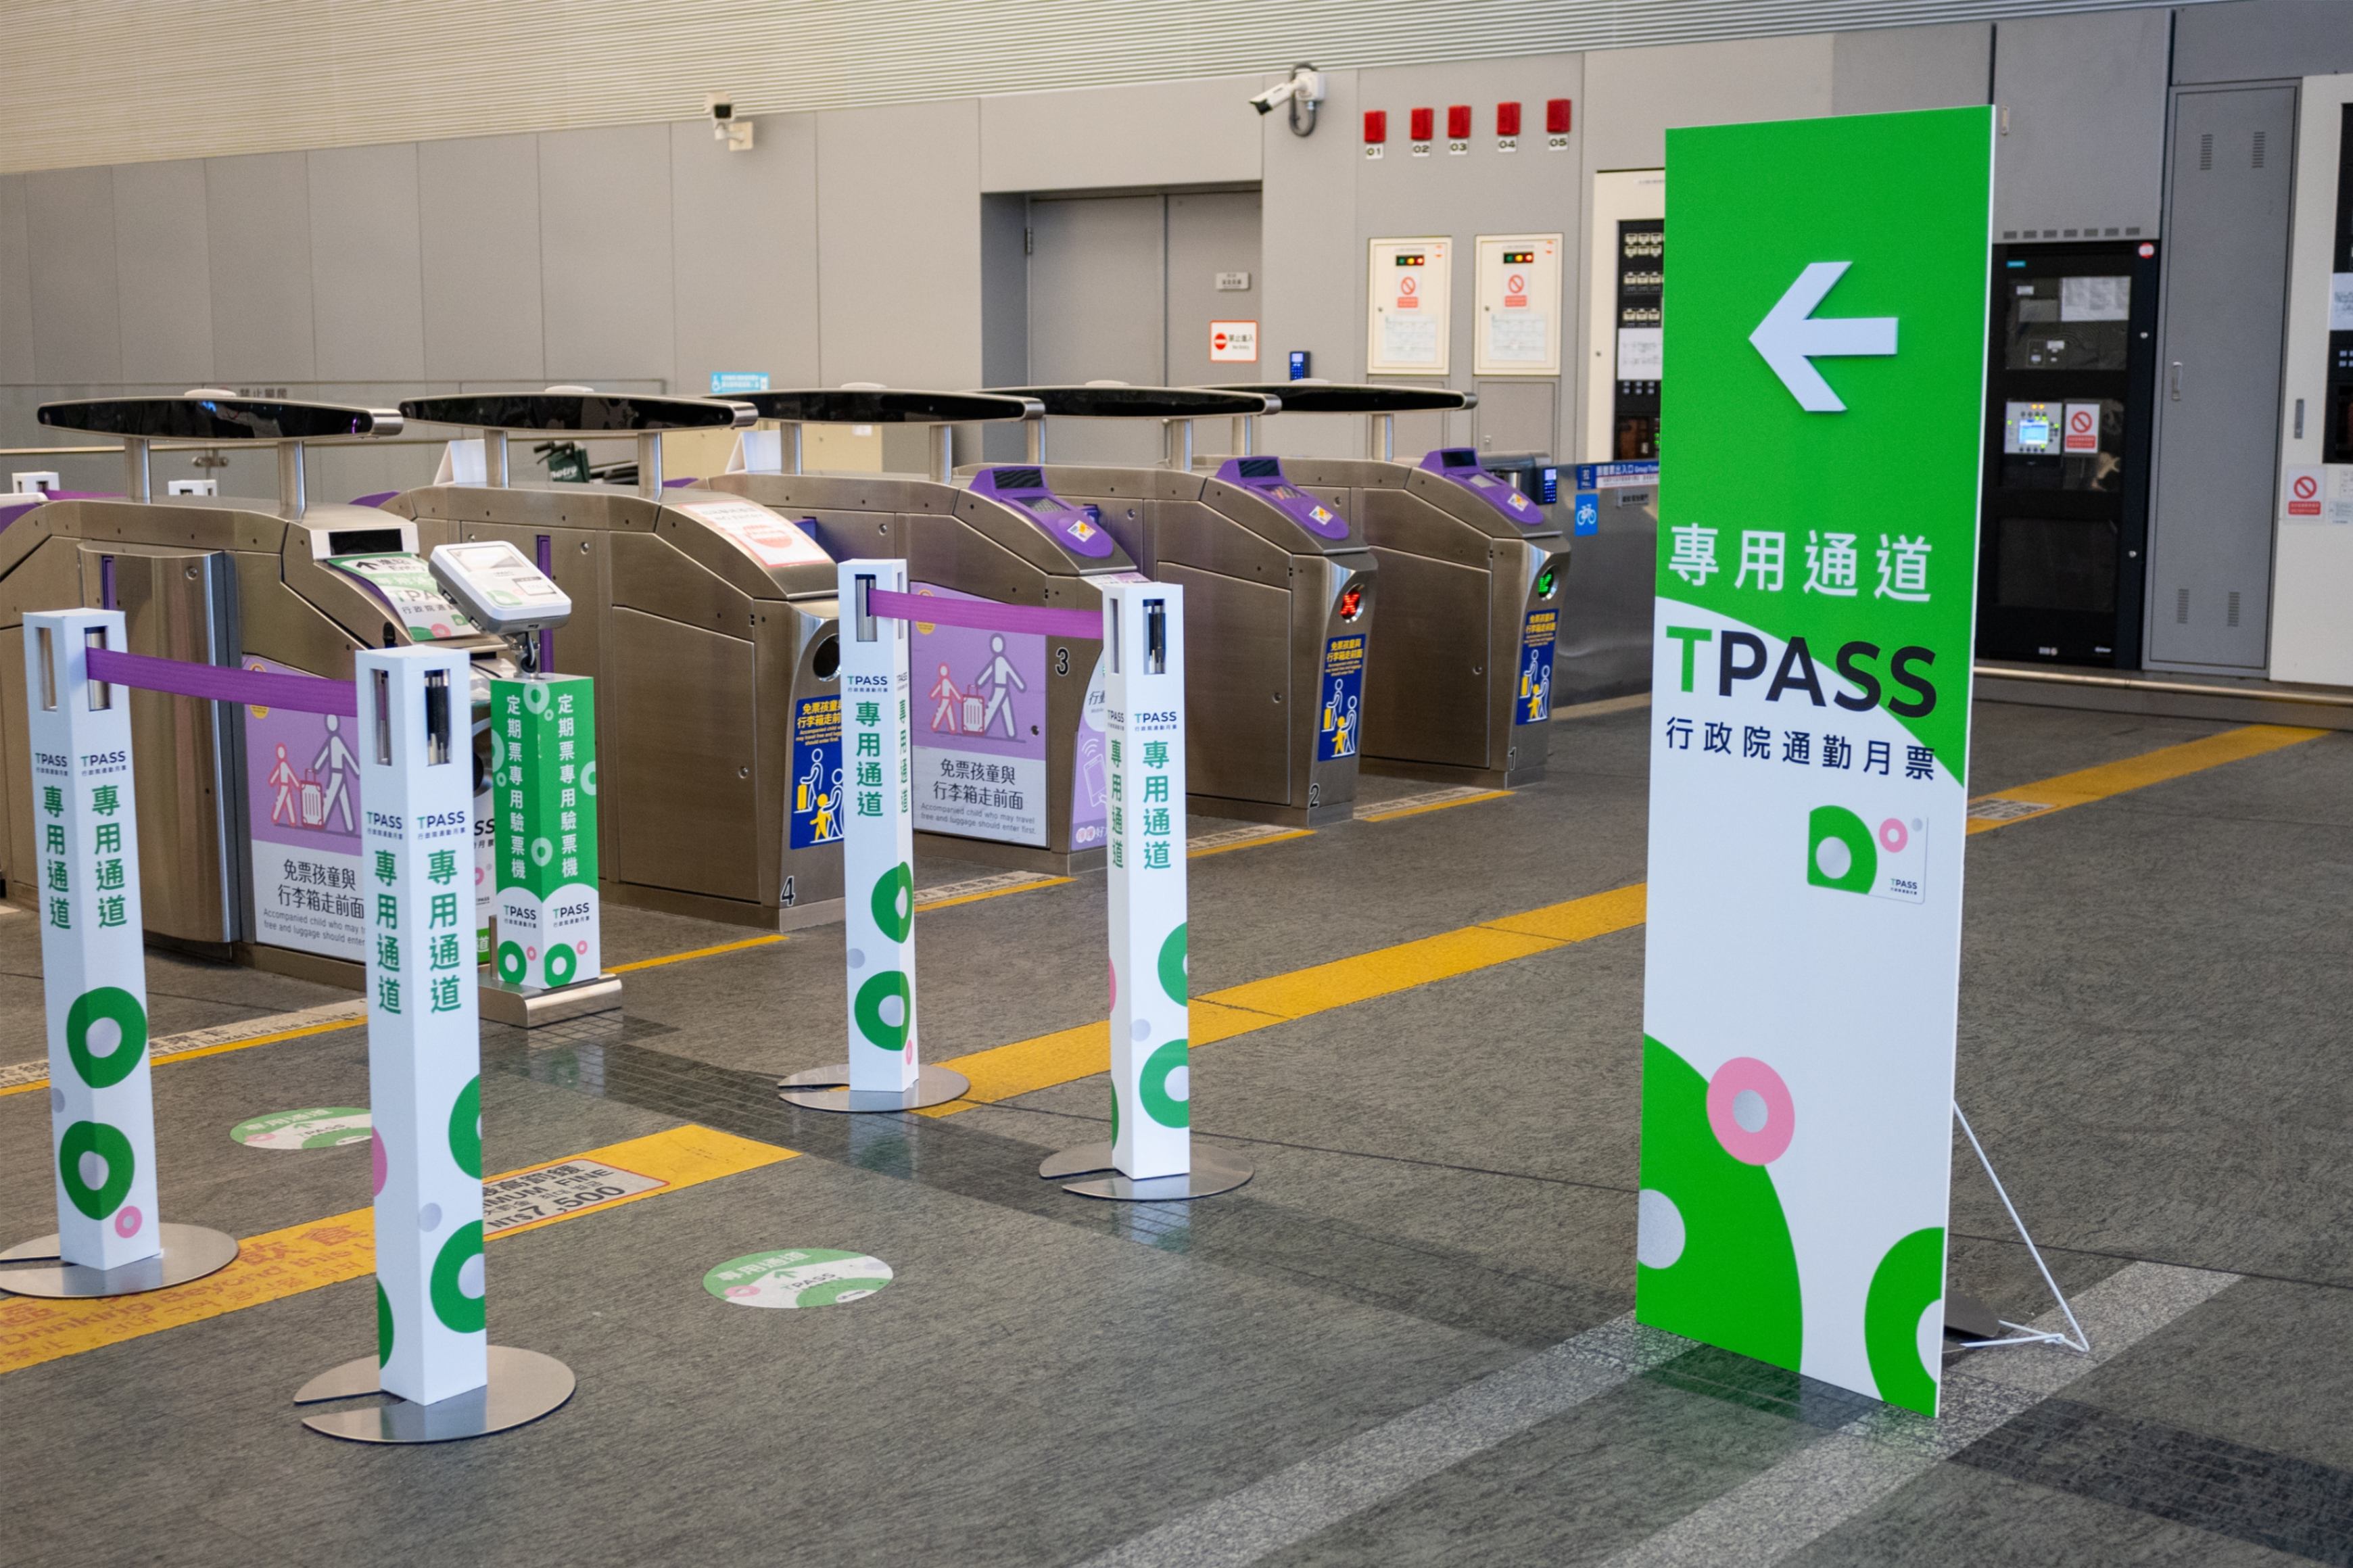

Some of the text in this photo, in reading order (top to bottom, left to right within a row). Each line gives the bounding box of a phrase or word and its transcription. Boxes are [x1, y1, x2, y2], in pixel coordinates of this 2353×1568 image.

[1366, 147, 1381, 156] 01
[1413, 145, 1430, 153] 02
[1450, 143, 1467, 151] 03
[1498, 141, 1516, 149] 04
[1550, 138, 1567, 147] 05
[1668, 523, 1932, 602] 專用通道
[388, 590, 443, 602] TPA
[402, 604, 455, 614] 行政院通
[1055, 647, 1070, 677] 3
[1666, 625, 1937, 718] TPASS
[847, 675, 888, 686] TPASS
[797, 712, 841, 730] 行李箱走前
[1108, 709, 1124, 723] TPASS
[1134, 711, 1177, 723] TPASS
[35, 753, 68, 767] TPASS
[80, 751, 126, 767] TPASS
[855, 700, 883, 817] 專用通道
[1508, 746, 1517, 771] 1
[1666, 717, 1934, 781] 行政院通勤月票
[941, 758, 1016, 786] 免票孩童與
[506, 694, 526, 880] 定期票專用驗票機
[558, 694, 578, 878] 定期票專用驗票機
[933, 781, 1024, 810] 行李箱走前面
[1309, 784, 1320, 808] 2
[921, 803, 1035, 824] Accompanied child who may travel
[1111, 739, 1124, 869] 專用通道
[1143, 740, 1171, 870] 專用通道
[366, 811, 402, 830] TPASS
[417, 811, 465, 830] TPASS
[921, 812, 1037, 835] free and luggage should enter first.
[43, 785, 72, 930] 專用通道
[91, 784, 128, 929] 專用通道
[284, 858, 356, 892] 免票孩童與
[1891, 879, 1918, 889] TPASS
[278, 884, 364, 920] 行李箱走前面
[780, 876, 795, 907] 4
[264, 907, 308, 924] Accompanied
[310, 917, 326, 928] child
[329, 920, 343, 930] who
[345, 924, 359, 934] may
[503, 905, 536, 920] TPASS
[552, 902, 590, 920] TPASS
[279, 922, 292, 933] and
[293, 925, 320, 940] luggage
[323, 931, 346, 943] should
[348, 936, 364, 947] enter
[375, 849, 402, 1015] 專用通道
[427, 849, 462, 1014] 專用通道
[483, 1169, 615, 1208] IMUM FINE
[483, 1199, 533, 1216] 大罰金
[780, 1272, 836, 1290] TPASS
[0, 1299, 156, 1345] Drinking
[157, 1263, 284, 1305] Beyond
[290, 1248, 353, 1269] this
